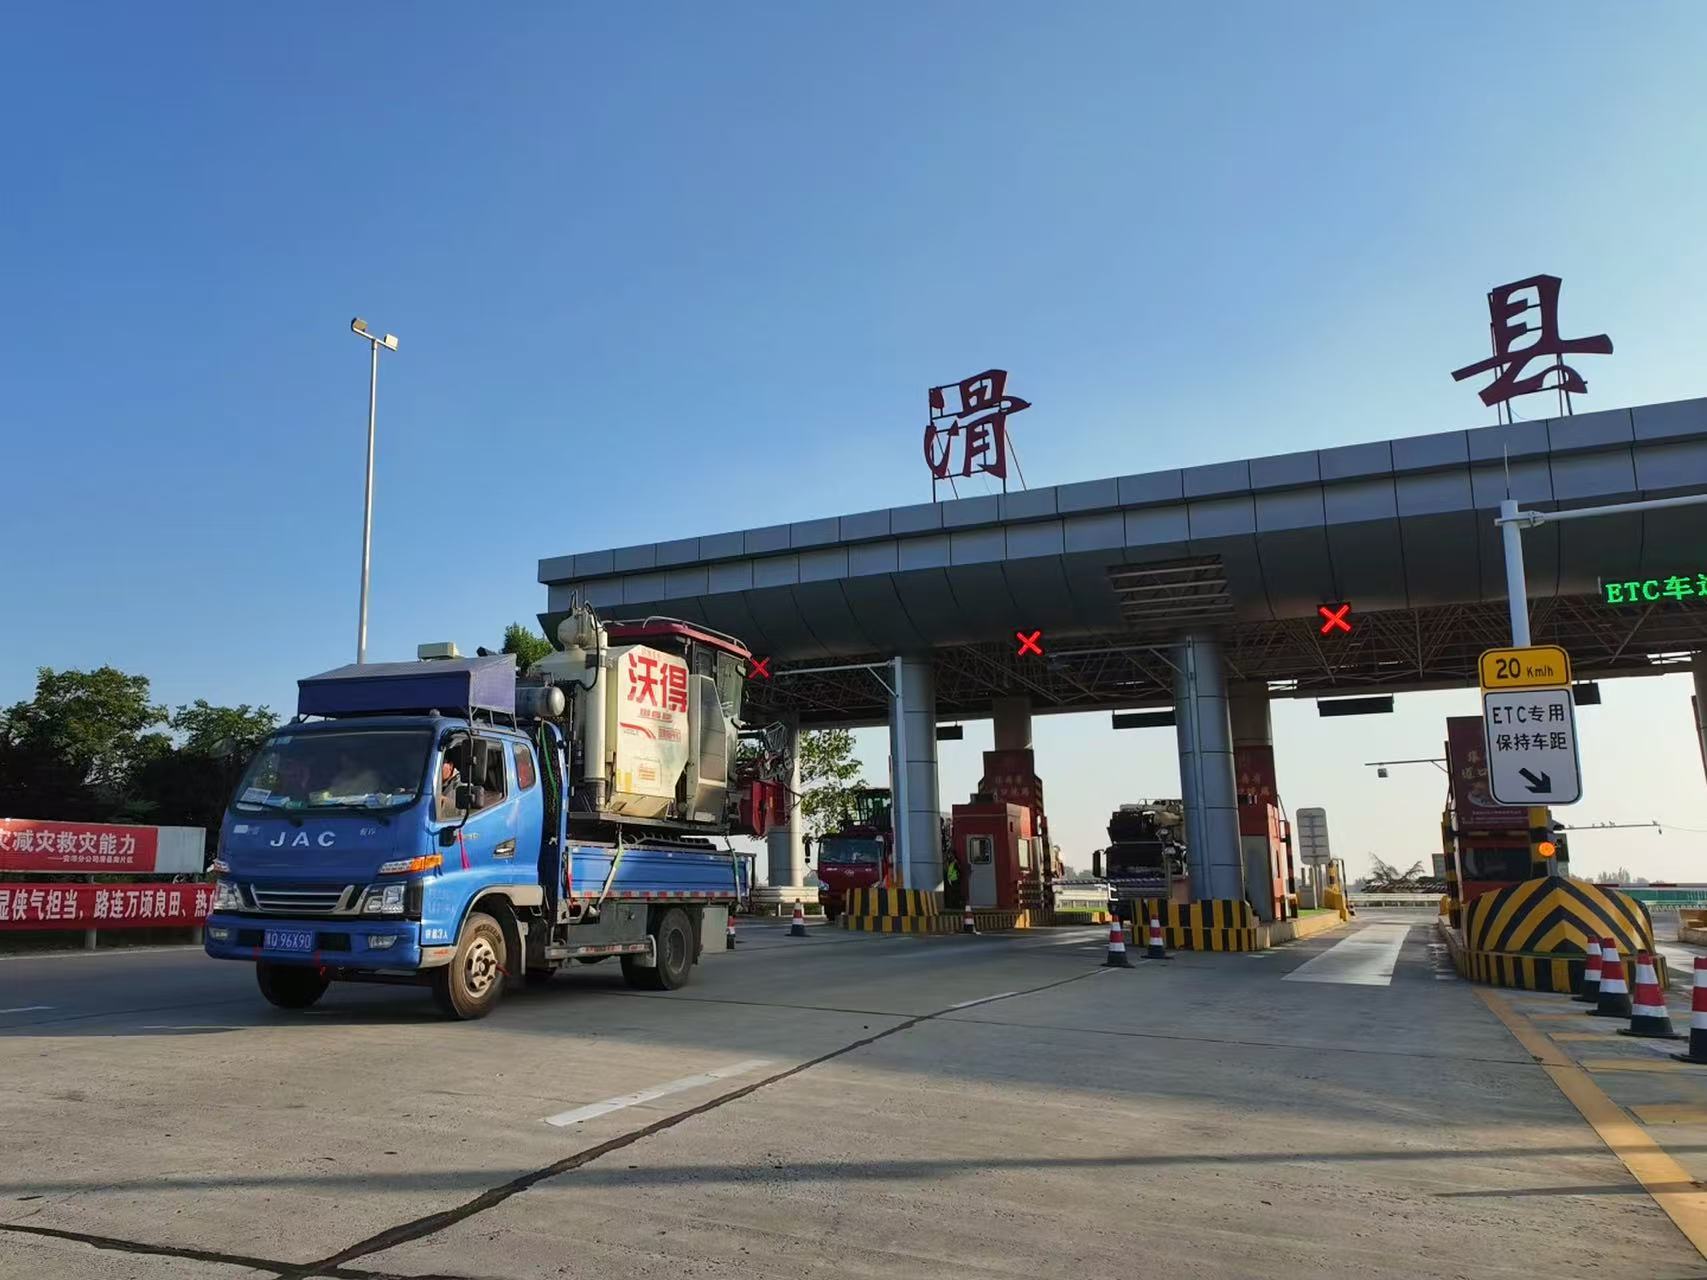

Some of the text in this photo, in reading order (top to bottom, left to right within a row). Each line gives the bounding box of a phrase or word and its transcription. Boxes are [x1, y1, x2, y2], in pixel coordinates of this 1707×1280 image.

[924, 274, 1614, 479] 滑 县
[1496, 657, 1554, 679] 20 Km/h
[627, 653, 688, 713] 沃得
[1492, 704, 1565, 724] ETC专用
[1496, 732, 1567, 751] 保持车距
[270, 831, 336, 847] JAC
